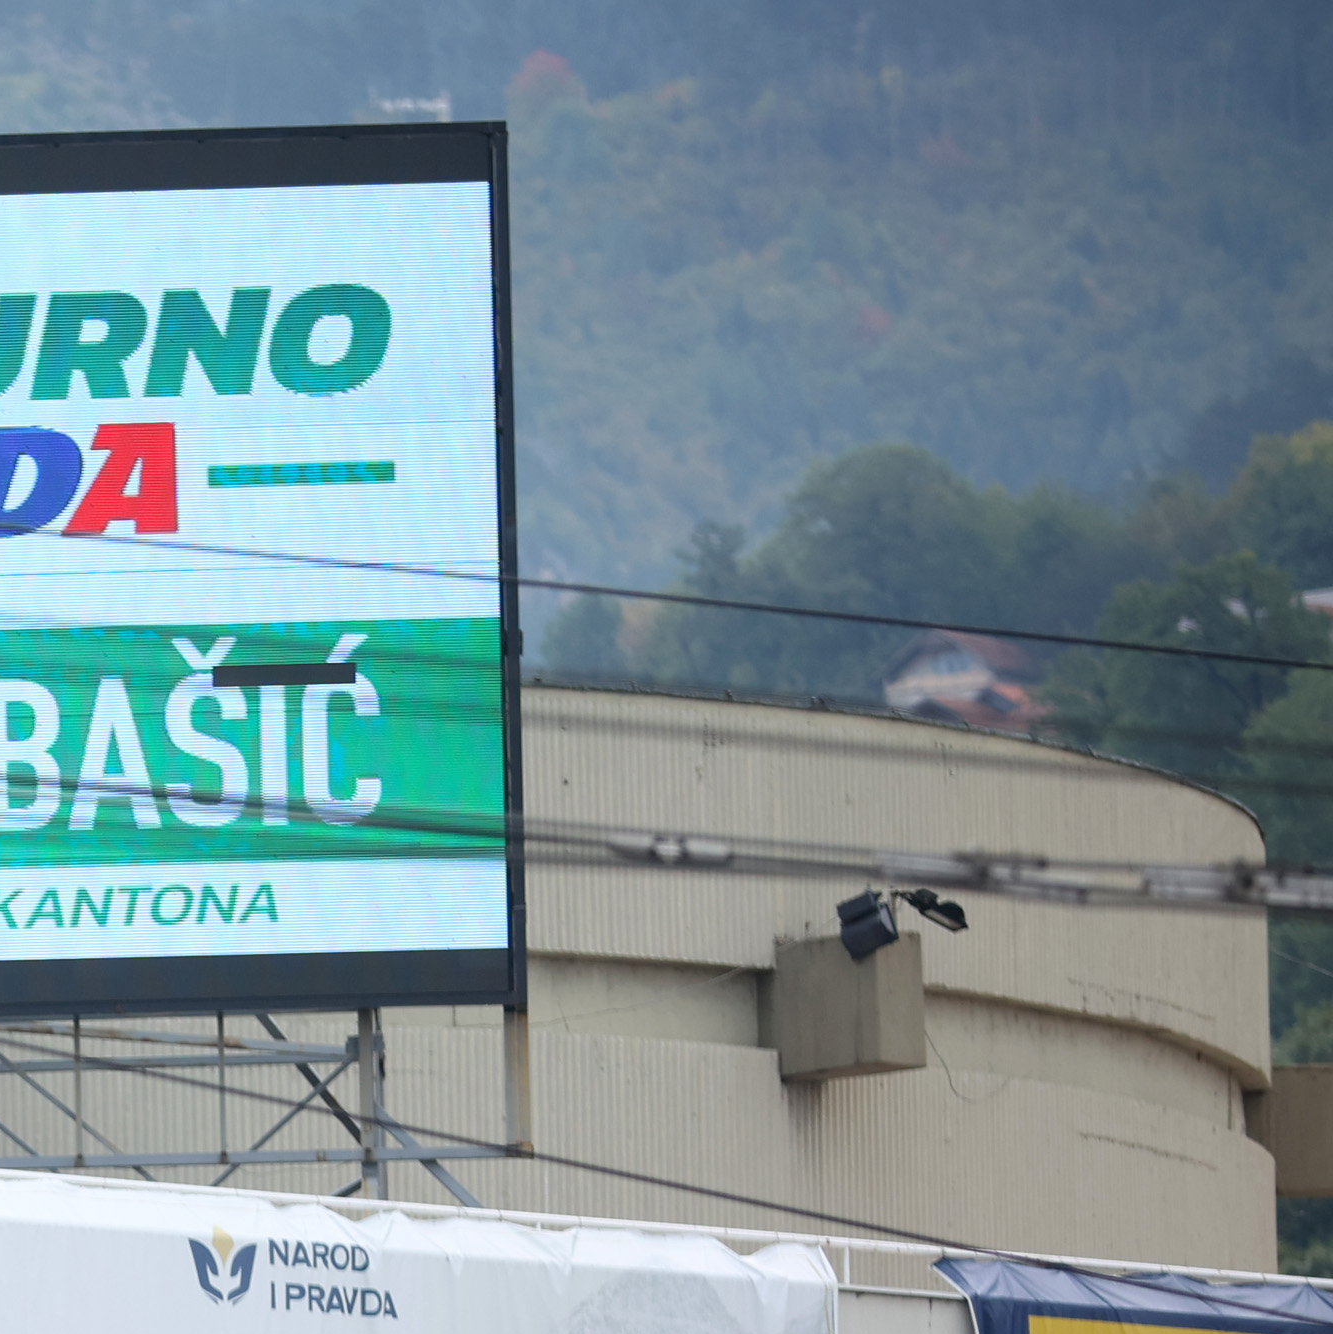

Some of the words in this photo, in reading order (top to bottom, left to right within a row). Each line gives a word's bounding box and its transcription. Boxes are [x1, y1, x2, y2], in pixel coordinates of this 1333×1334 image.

[268, 1238, 370, 1272] NAROD
[270, 1281, 276, 1309] I
[285, 1282, 398, 1319] PRAVDA
